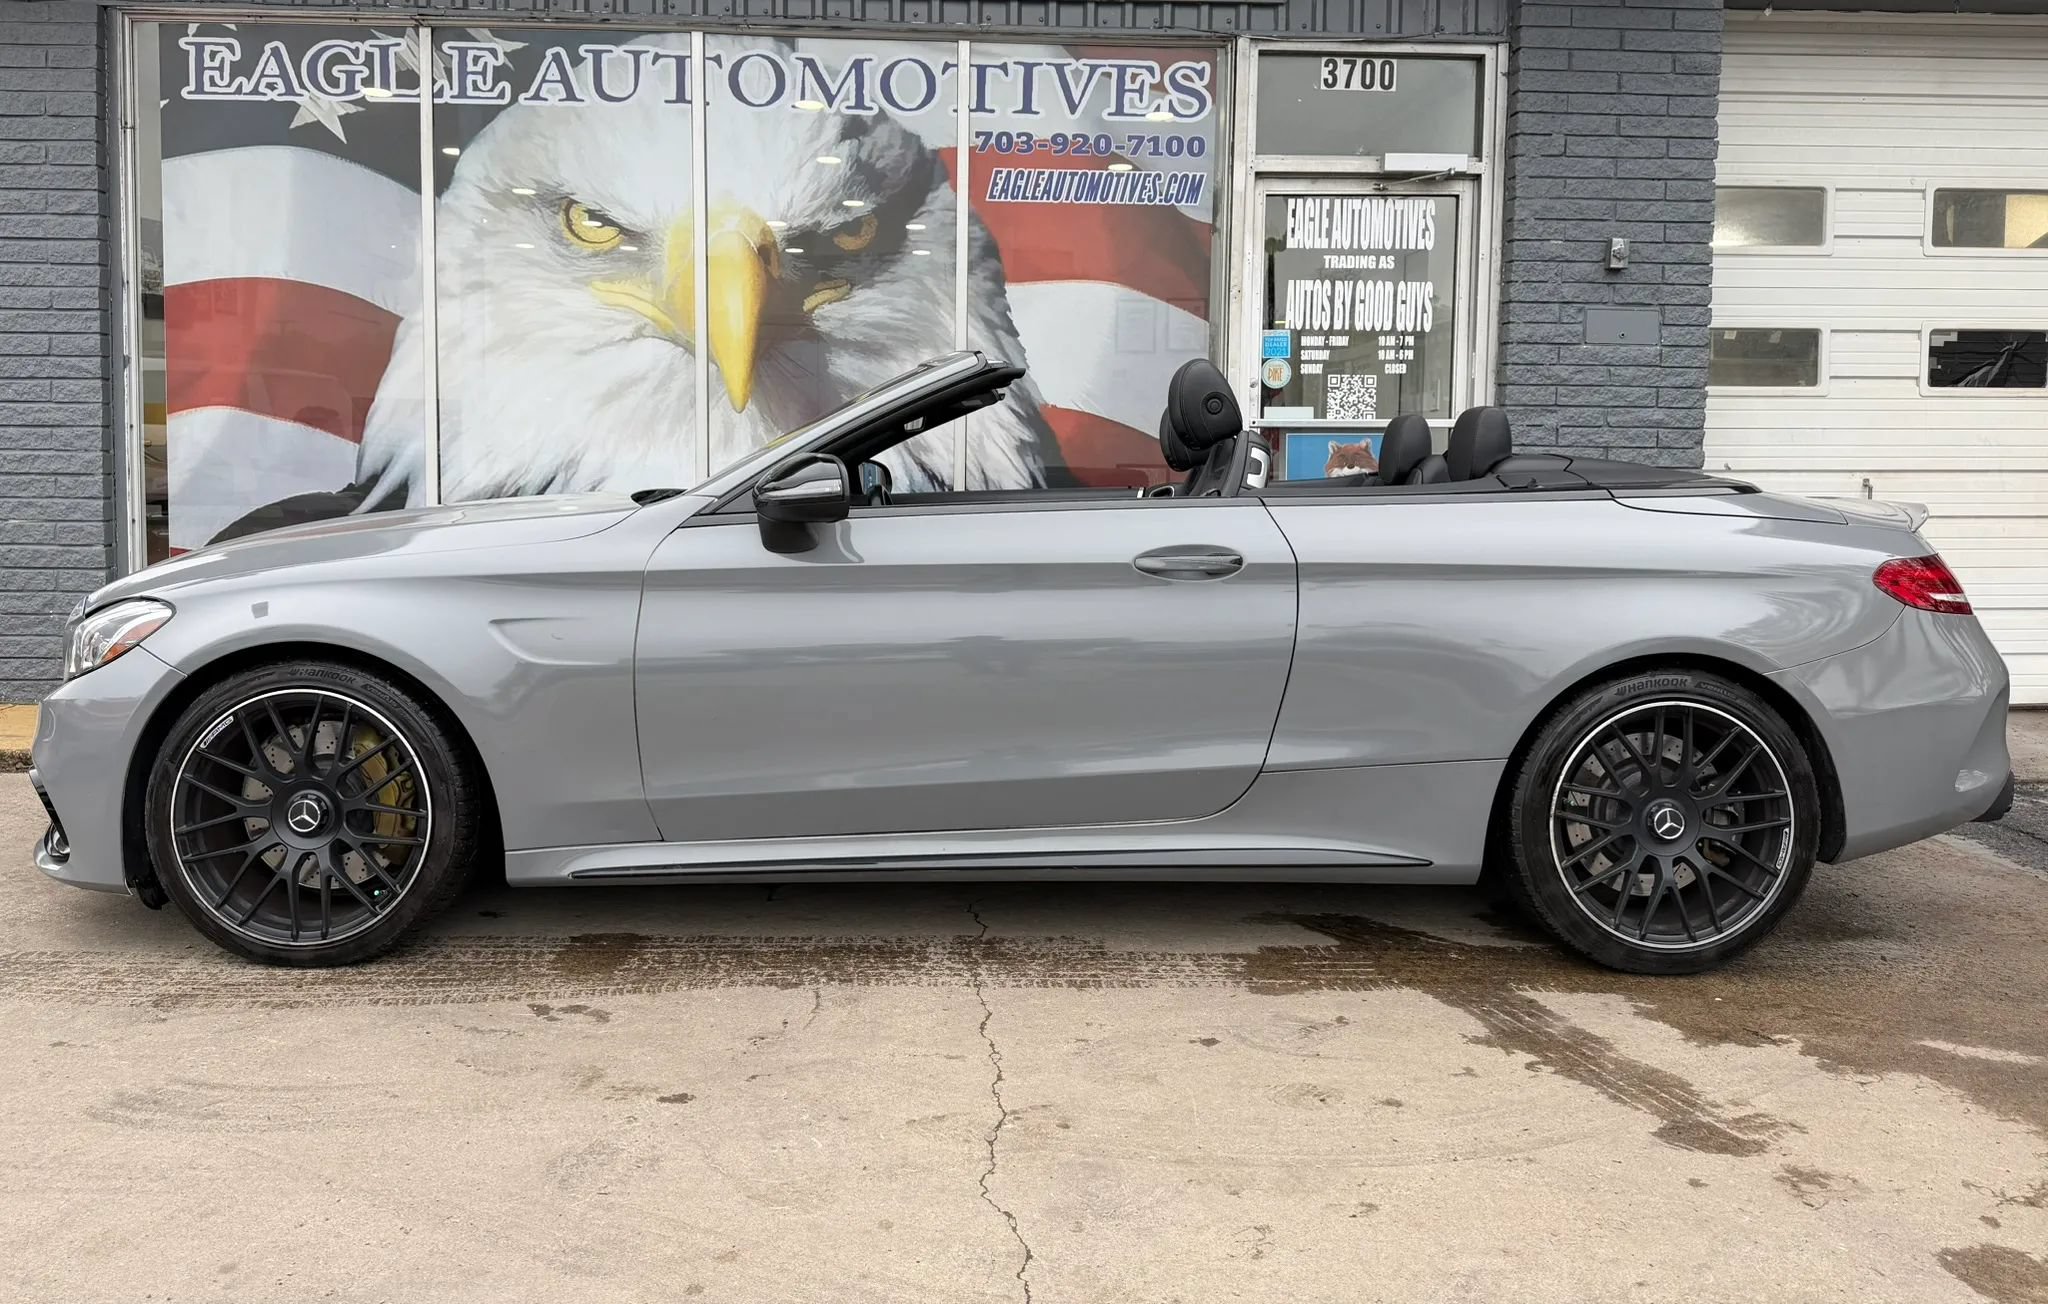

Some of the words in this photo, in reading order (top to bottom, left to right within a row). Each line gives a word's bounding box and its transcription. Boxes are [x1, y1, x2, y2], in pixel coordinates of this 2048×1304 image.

[180, 37, 511, 105] EAGLE
[518, 45, 1213, 122] AUTOMOTIVES
[1323, 58, 1395, 91] 3700
[974, 130, 1206, 158] 703-920-7100
[986, 168, 1207, 206] EAGLEAUTOMOTIVES.COM
[1286, 198, 1330, 249] EAGLE
[1331, 198, 1436, 251] AUTOMOTIVES
[1323, 255, 1376, 269] TRADING
[1378, 256, 1395, 269] AS
[1285, 279, 1332, 331] AUTOS
[1333, 280, 1354, 331] BY
[1354, 280, 1395, 332] GOOD
[1396, 280, 1434, 332] GUYS
